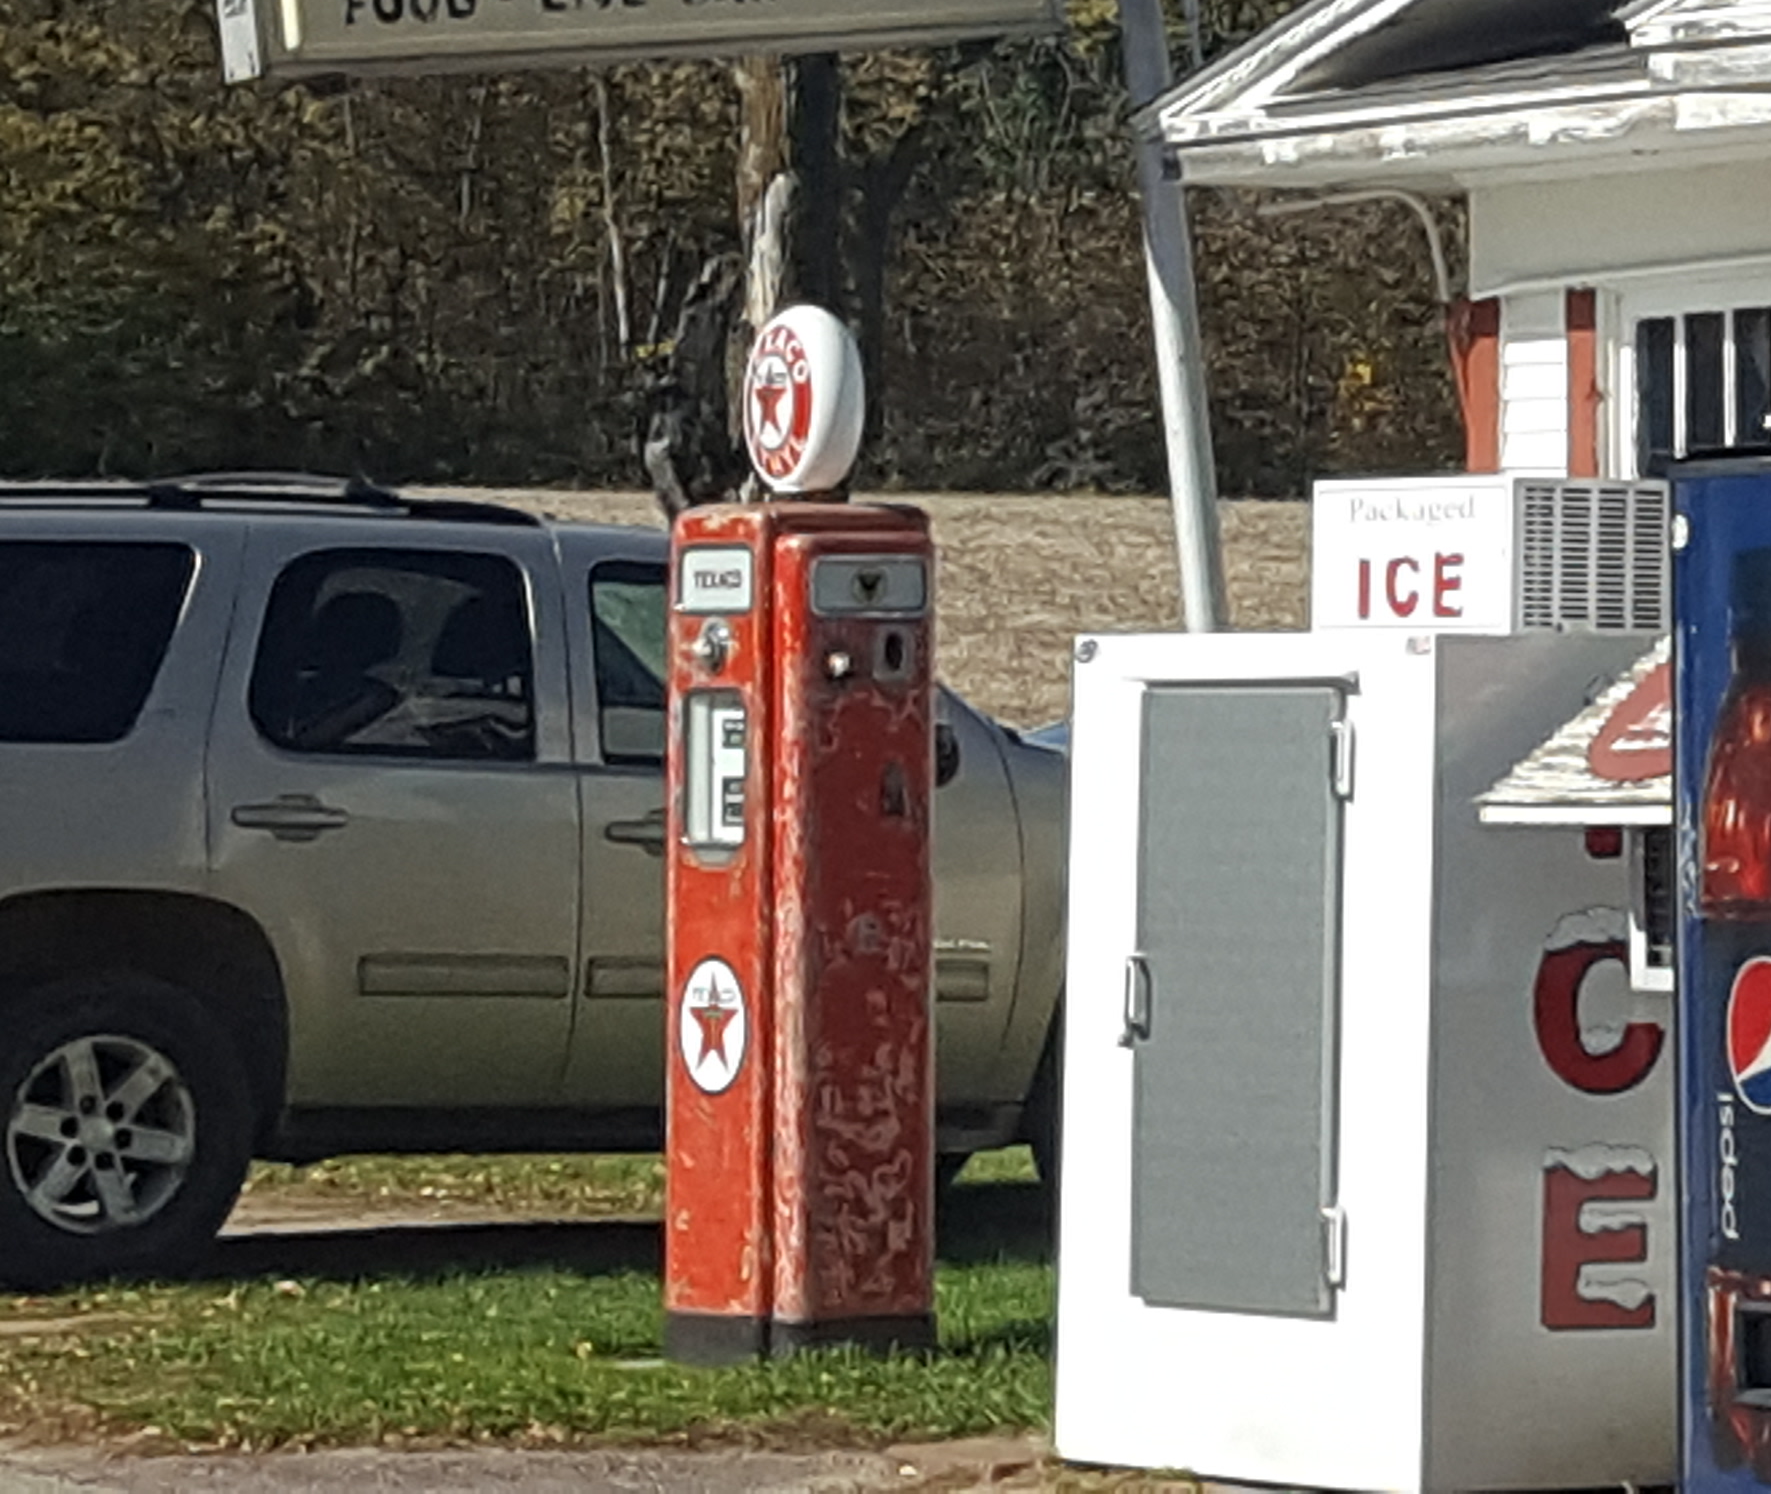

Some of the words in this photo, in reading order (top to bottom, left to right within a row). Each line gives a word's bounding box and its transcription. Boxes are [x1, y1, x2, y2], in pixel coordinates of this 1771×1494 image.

[1349, 493, 1476, 526] Packaged
[1357, 551, 1465, 620] ICE
[1716, 1092, 1740, 1240] pepsi
